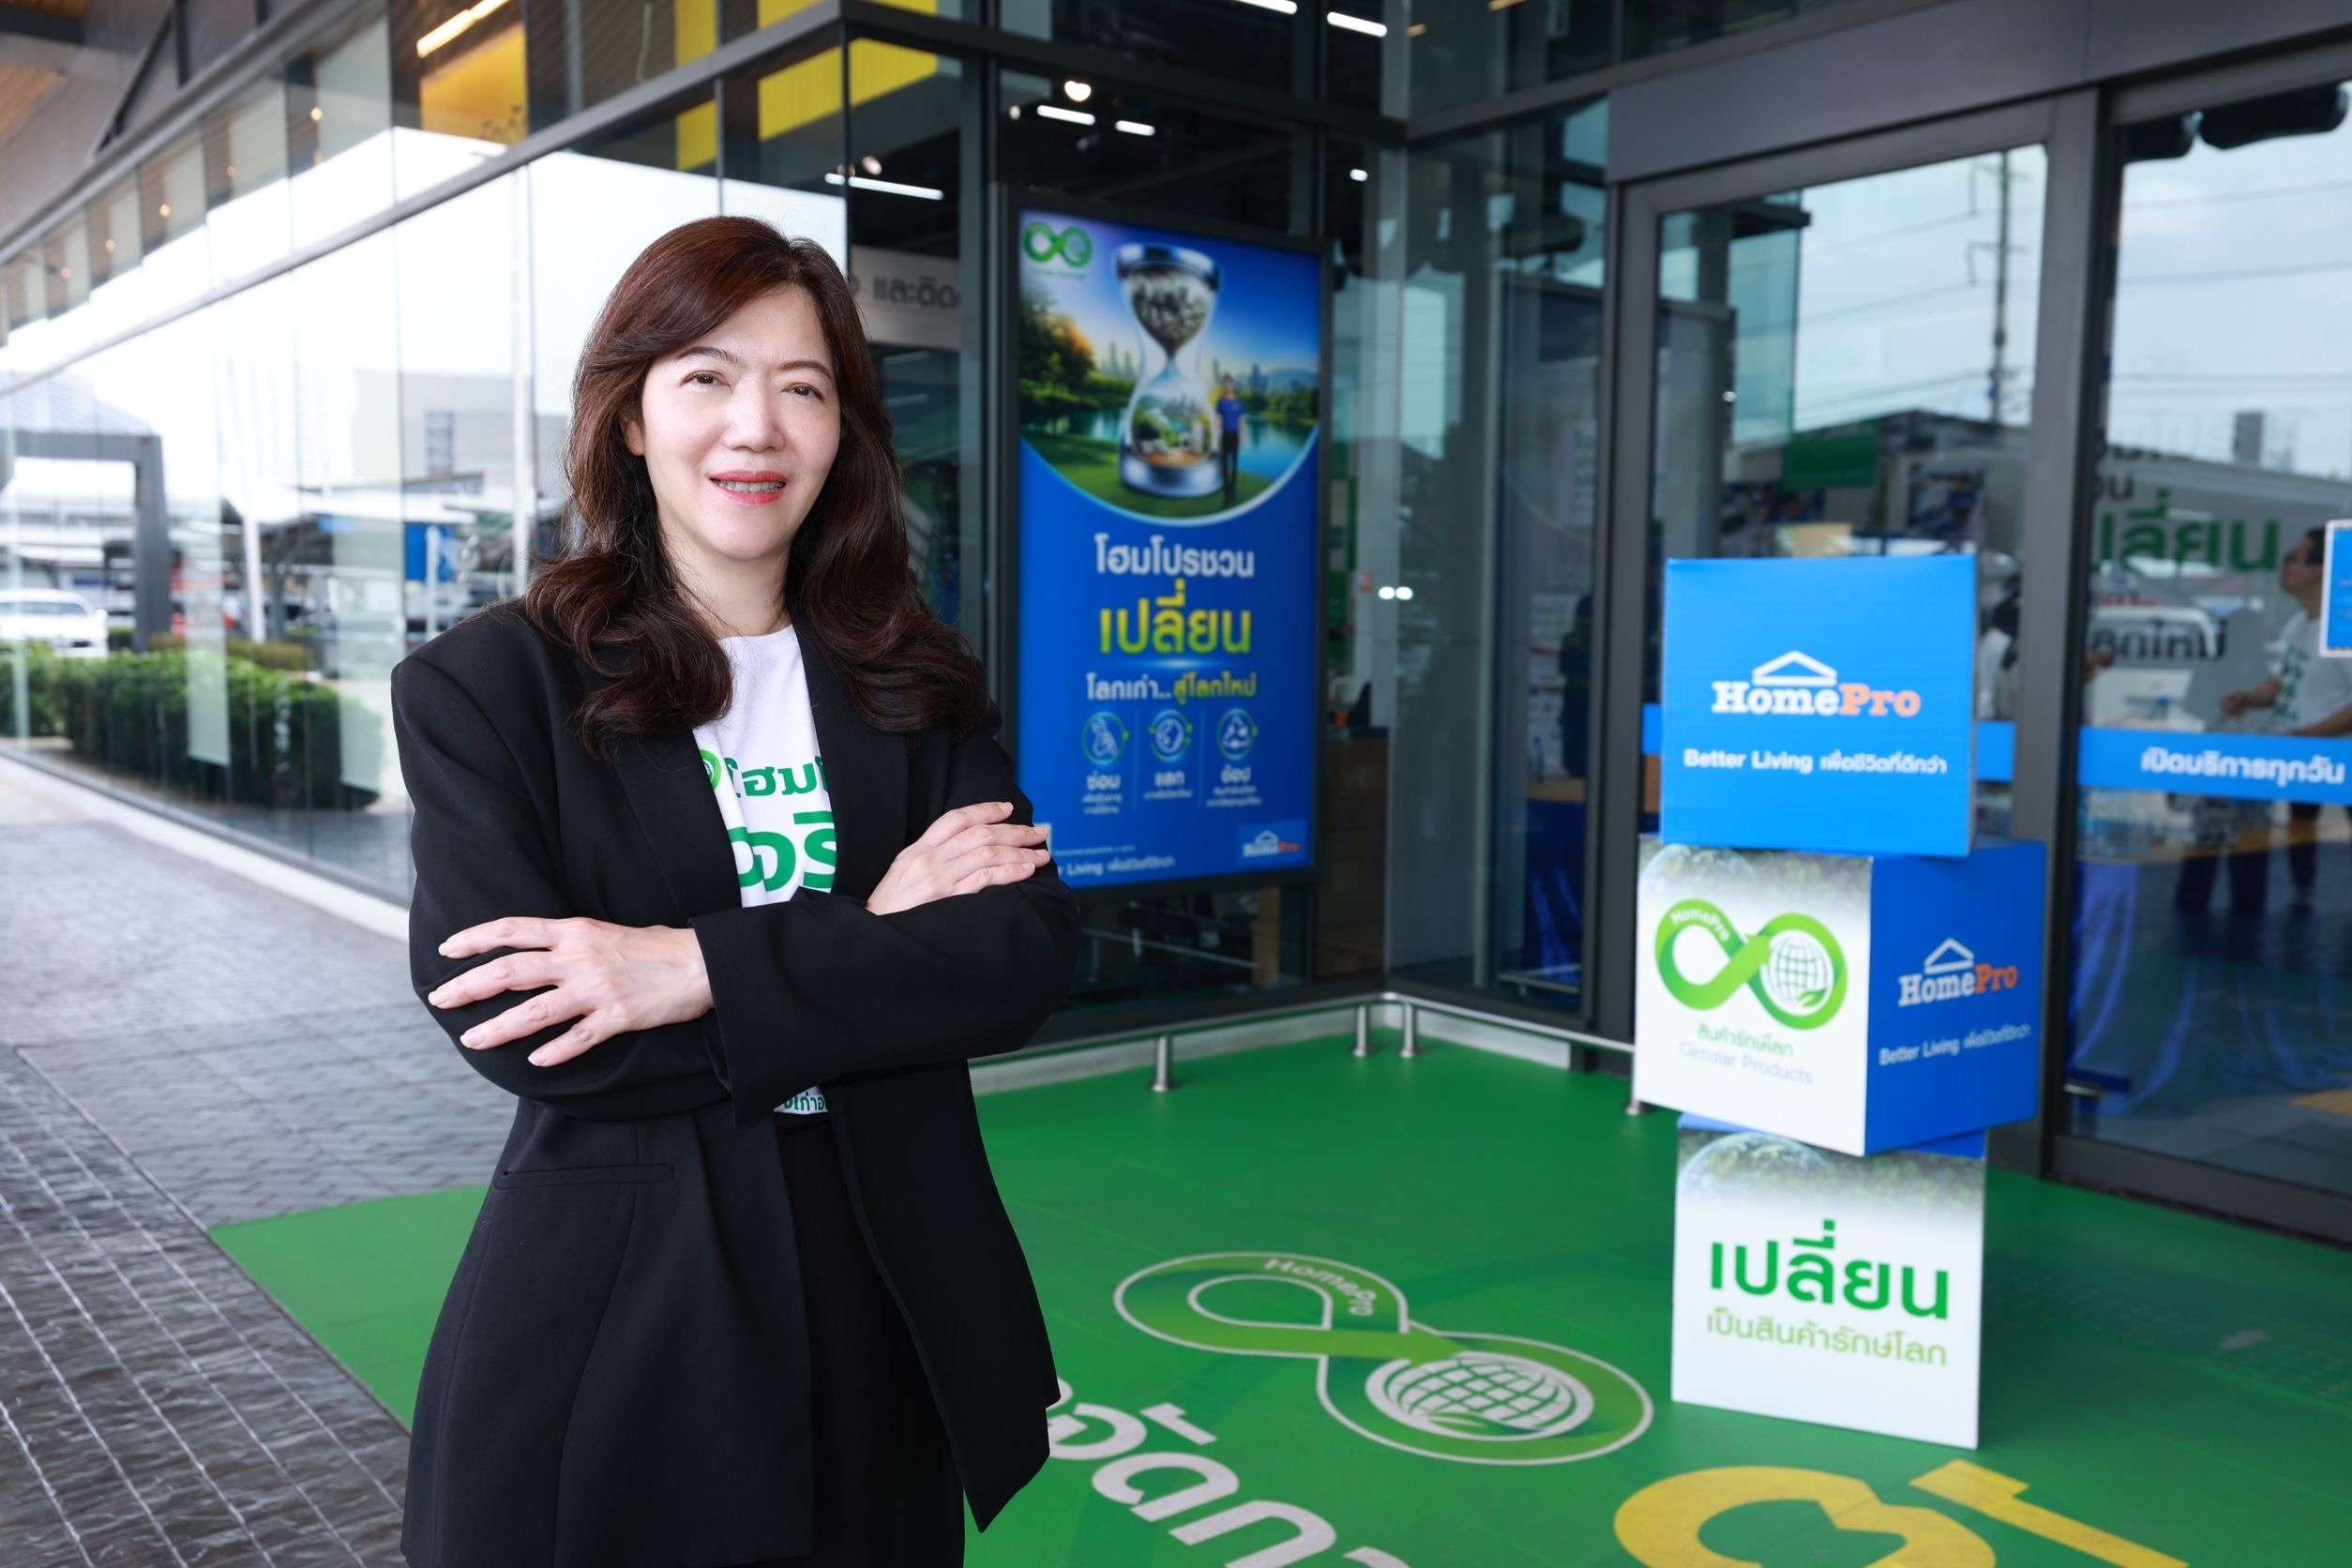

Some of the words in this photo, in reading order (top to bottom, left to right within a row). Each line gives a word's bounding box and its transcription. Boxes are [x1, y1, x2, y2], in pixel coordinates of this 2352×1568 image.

[1094, 533, 1255, 579] โฮมโปรชวน
[1099, 577, 1252, 655] เปลี่ยน
[1711, 680, 1922, 718] HomePro
[1682, 748, 1746, 770] Better
[1751, 750, 1813, 774] Living
[2140, 746, 2346, 788] เปิดบริการทุกวัน
[1898, 963, 2019, 1007] HomePro
[1680, 1041, 1735, 1067] Circular
[1741, 1054, 1814, 1084] Products
[1877, 1045, 1920, 1067] Better
[1922, 1038, 1960, 1058] Living
[1263, 1258, 1378, 1317] HomePro
[1710, 1219, 1950, 1319] เปลี่ยน
[1706, 1305, 1949, 1366] เป็นสินค้ารักษ์โลก
